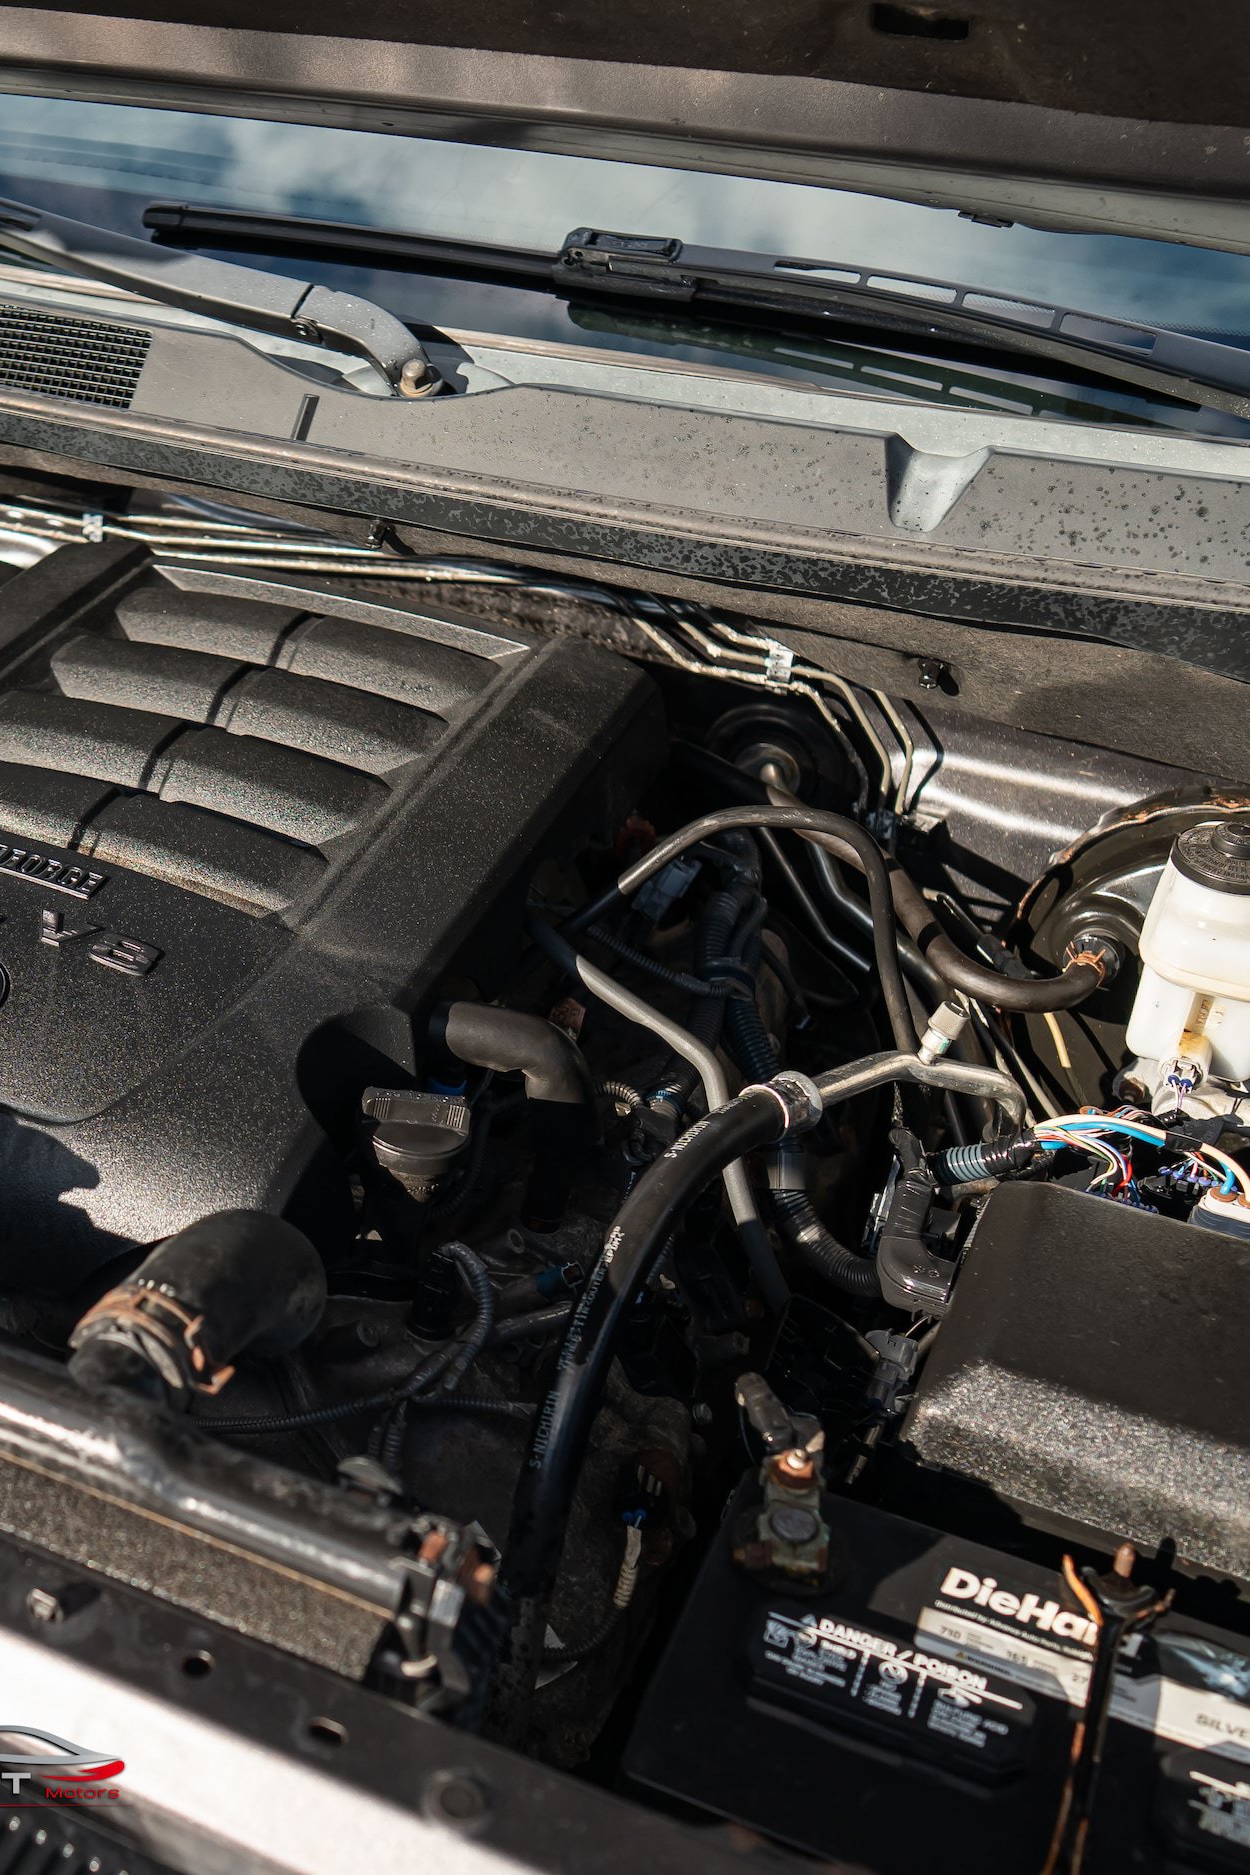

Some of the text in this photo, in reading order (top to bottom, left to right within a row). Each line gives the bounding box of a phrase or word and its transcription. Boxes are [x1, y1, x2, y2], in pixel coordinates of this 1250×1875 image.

[40, 908, 165, 976] V8
[819, 1618, 897, 1657] DANGER
[913, 1653, 987, 1690] POISON
